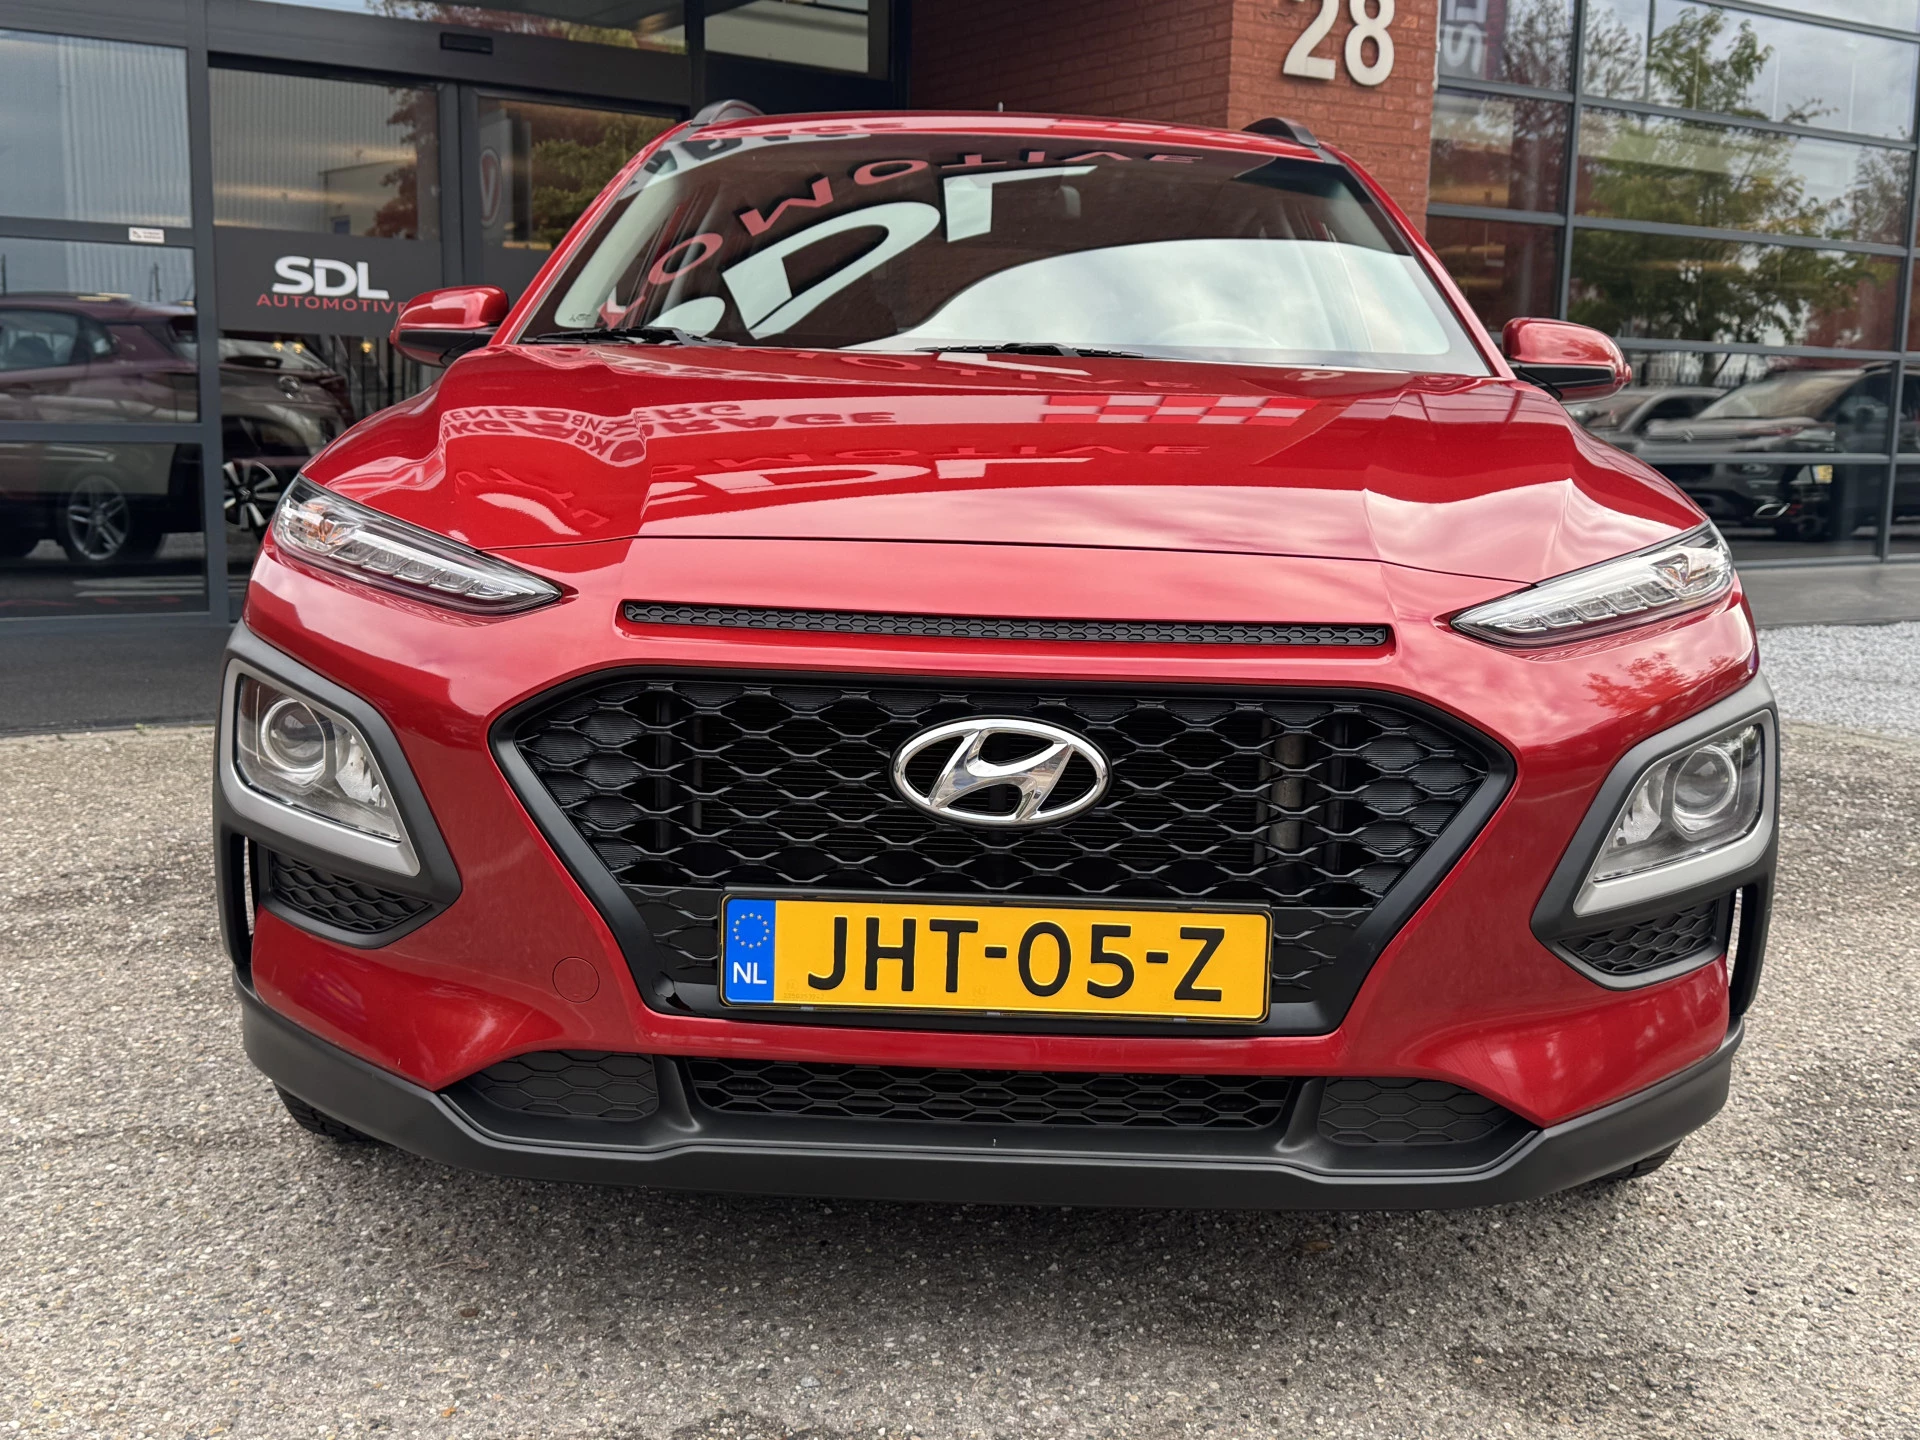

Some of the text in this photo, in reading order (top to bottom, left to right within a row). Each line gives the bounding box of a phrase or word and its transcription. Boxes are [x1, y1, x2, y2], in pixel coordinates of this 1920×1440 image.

[1283, 0, 1395, 86] 28
[271, 255, 390, 300] SDL
[733, 961, 768, 985] NL
[807, 915, 1227, 1002] JHT-05-Z
